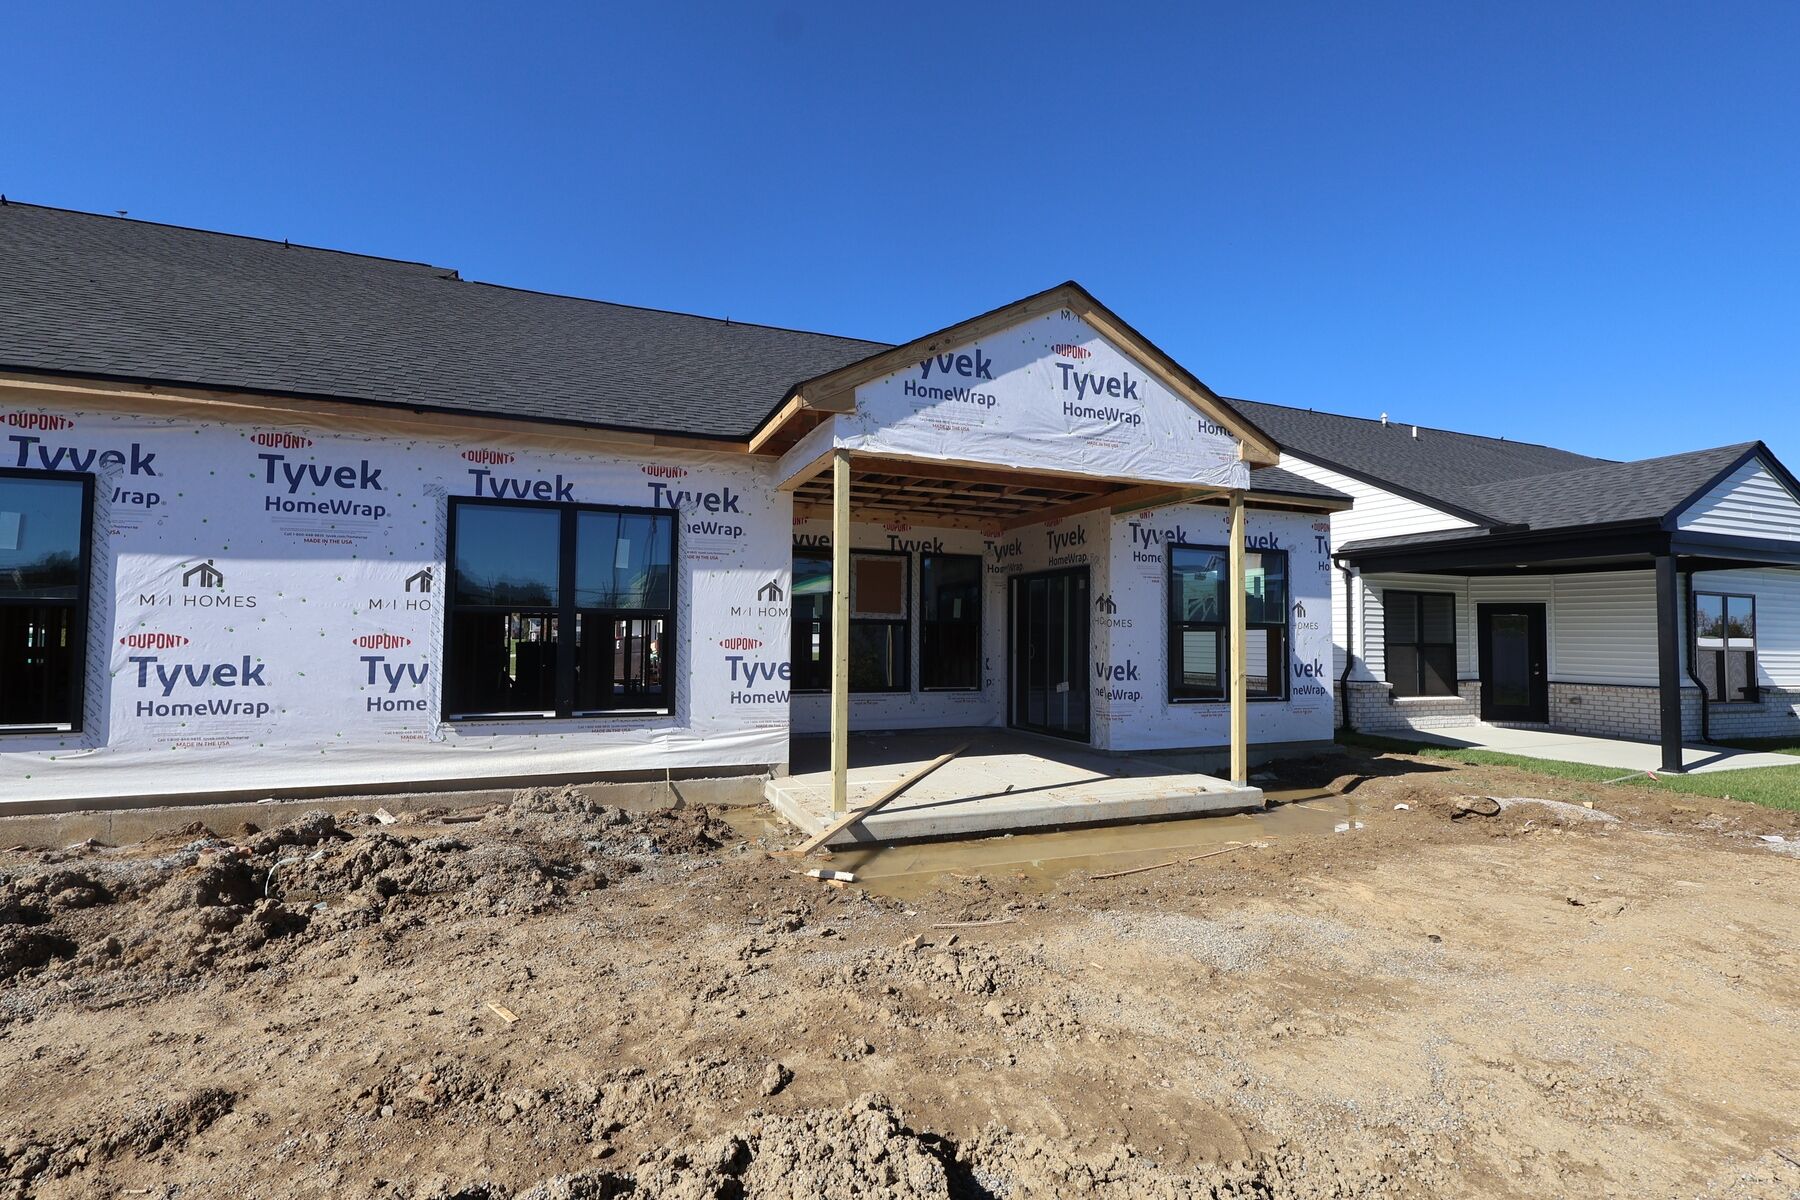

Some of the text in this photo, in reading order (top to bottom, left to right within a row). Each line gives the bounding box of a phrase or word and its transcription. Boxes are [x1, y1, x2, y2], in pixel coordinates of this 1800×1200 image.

[1056, 344, 1087, 359] DUPONT
[1055, 362, 1138, 400] Tyvek
[904, 380, 996, 409] HomeWrap
[9, 413, 66, 430] DUPONT
[1063, 401, 1141, 427] HomeWrap
[258, 433, 306, 448] DUPONT
[468, 450, 509, 465] DUPONT
[258, 453, 382, 493] Tyvek
[647, 465, 682, 478] DUPONT
[265, 496, 386, 519] HomeWrap
[1047, 525, 1085, 554] Tyvek
[1049, 553, 1087, 566] HomeWrap
[139, 594, 257, 607] M/I HOMES
[369, 599, 396, 610] M/I
[129, 633, 182, 649] DUPONT
[360, 635, 405, 649] DUPONT
[725, 638, 758, 650] DUPONT
[129, 655, 265, 697] Tyvek
[360, 656, 429, 693] Tyv
[725, 656, 791, 688] Tyve
[136, 699, 270, 718] HomeWrap
[367, 697, 427, 712] Home
